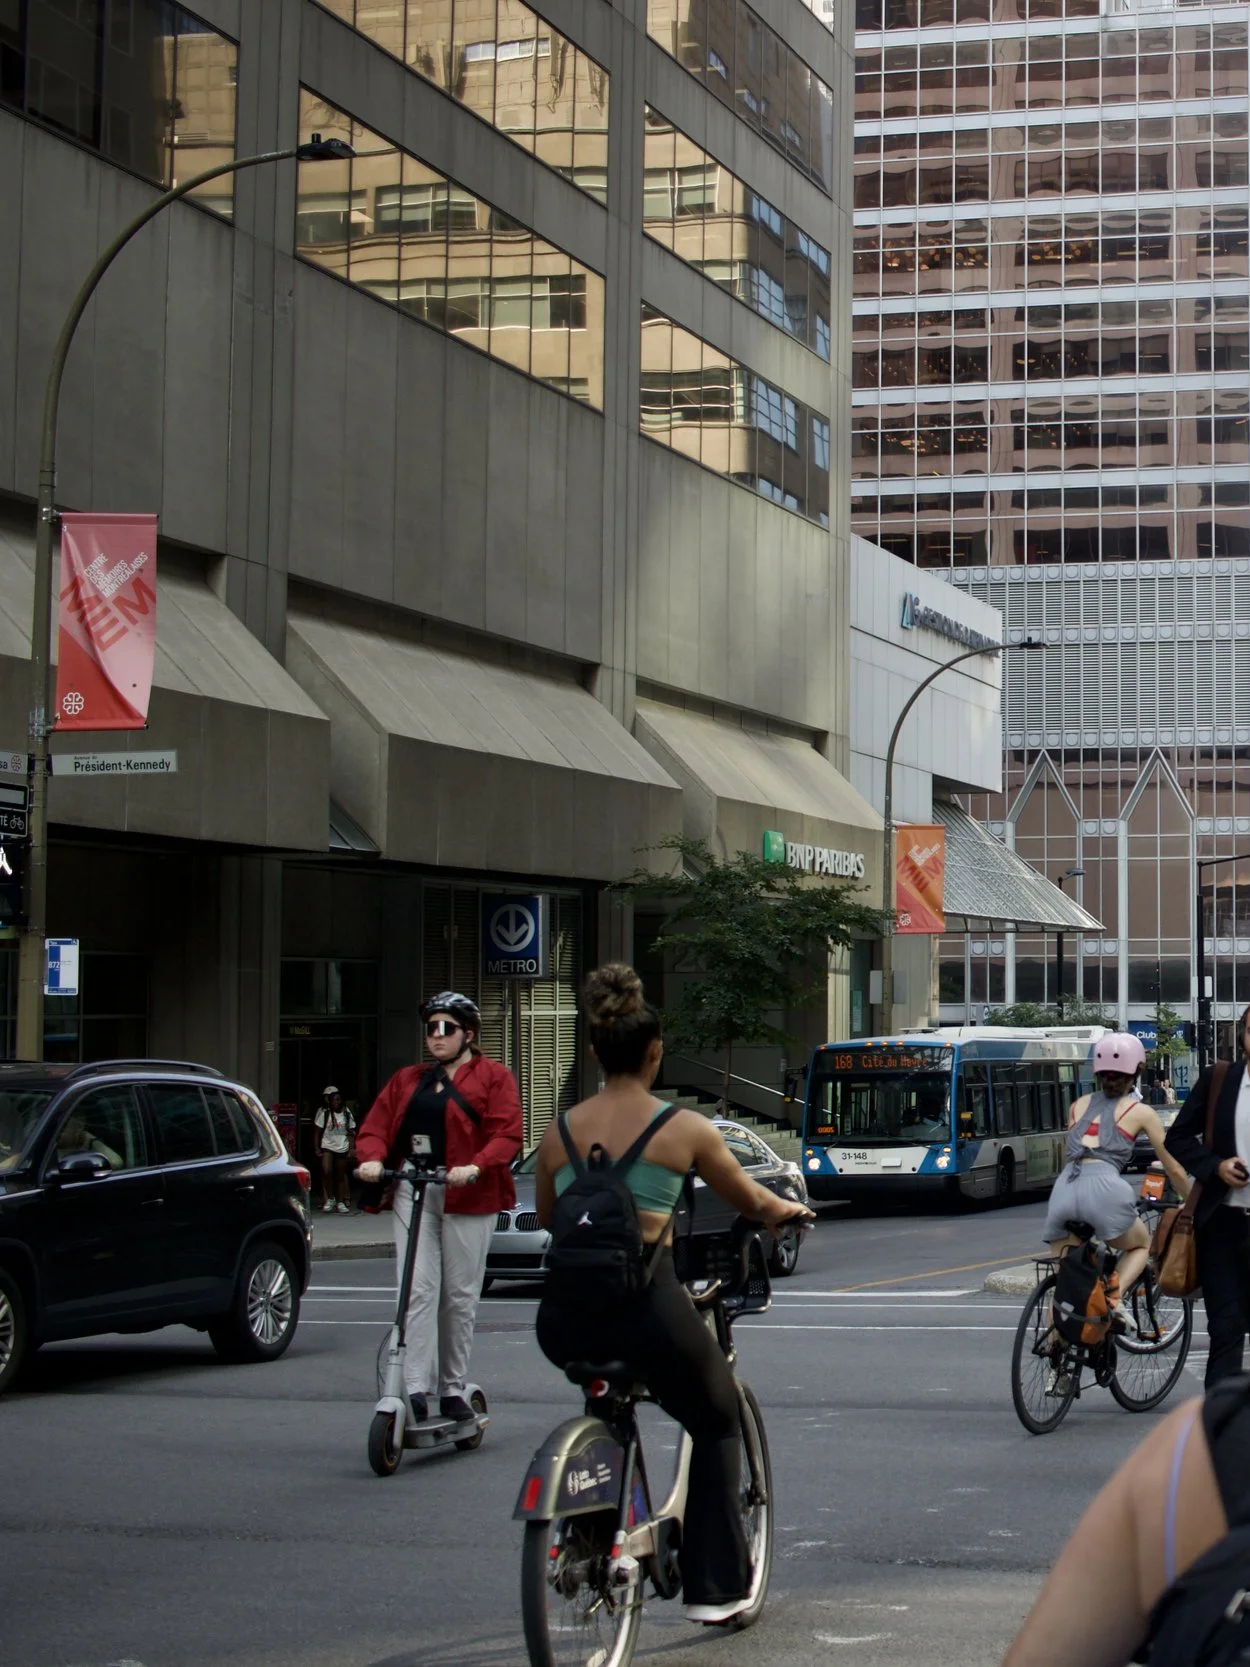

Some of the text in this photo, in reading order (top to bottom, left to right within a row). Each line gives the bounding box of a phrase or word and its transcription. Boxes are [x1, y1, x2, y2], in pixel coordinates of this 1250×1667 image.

[84, 552, 109, 577] CENTRE
[90, 569, 105, 585] DES
[74, 758, 171, 773] Président-Kennedy
[786, 841, 865, 878] BNP PARIBAS
[488, 959, 537, 973] METRO
[1136, 1030, 1157, 1039] Club
[835, 1055, 853, 1069] 168
[841, 1152, 868, 1160] 31-148
